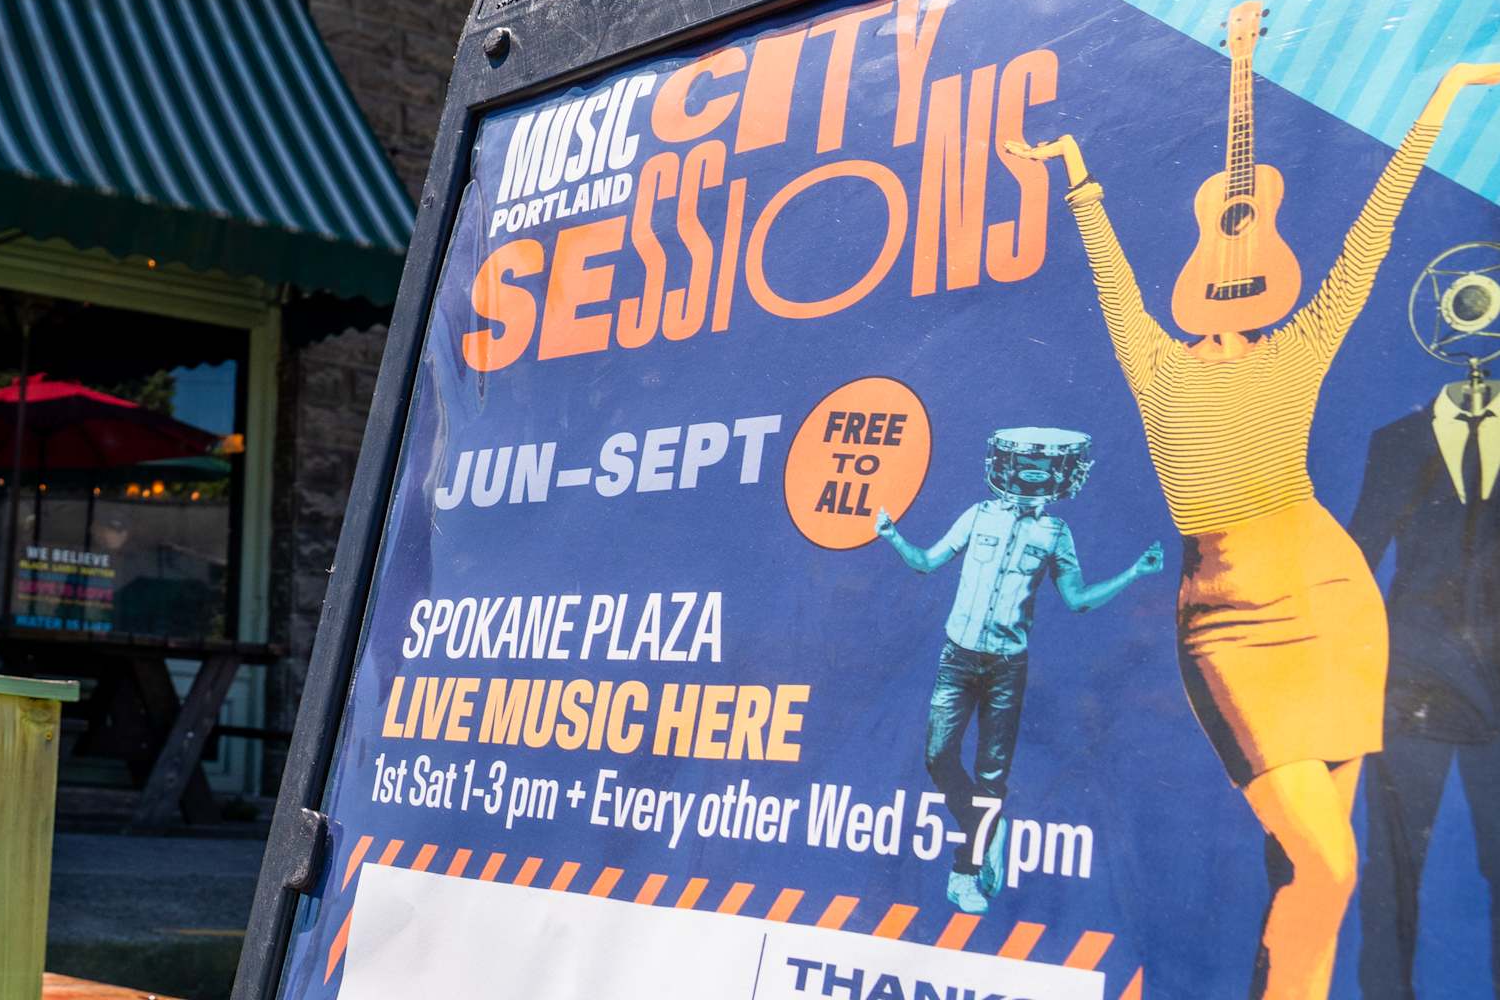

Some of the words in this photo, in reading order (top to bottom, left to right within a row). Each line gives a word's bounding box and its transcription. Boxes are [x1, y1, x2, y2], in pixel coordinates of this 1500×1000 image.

[497, 71, 657, 204] MUSIC
[462, 49, 1059, 372] SESSIONS
[488, 172, 633, 239] PORTLAND
[822, 411, 908, 447] FREE
[833, 453, 881, 476] TO
[815, 482, 873, 517] ALL
[26, 546, 49, 560] WE
[52, 548, 110, 568] BELIEVE
[402, 594, 581, 661] SPOKANE
[580, 591, 724, 663] PLAZA
[381, 676, 481, 742] LIVE
[478, 679, 650, 755] MUSIC
[652, 683, 811, 762] HERE
[371, 752, 408, 805] 1st
[409, 754, 458, 809] Sat
[460, 758, 508, 815] 1-3
[506, 775, 560, 830] pm
[566, 779, 587, 809] +
[590, 769, 696, 850] Every
[697, 779, 800, 844] other
[806, 782, 905, 856] Wed
[911, 791, 1002, 867] 5-7
[1006, 817, 1095, 889] pm
